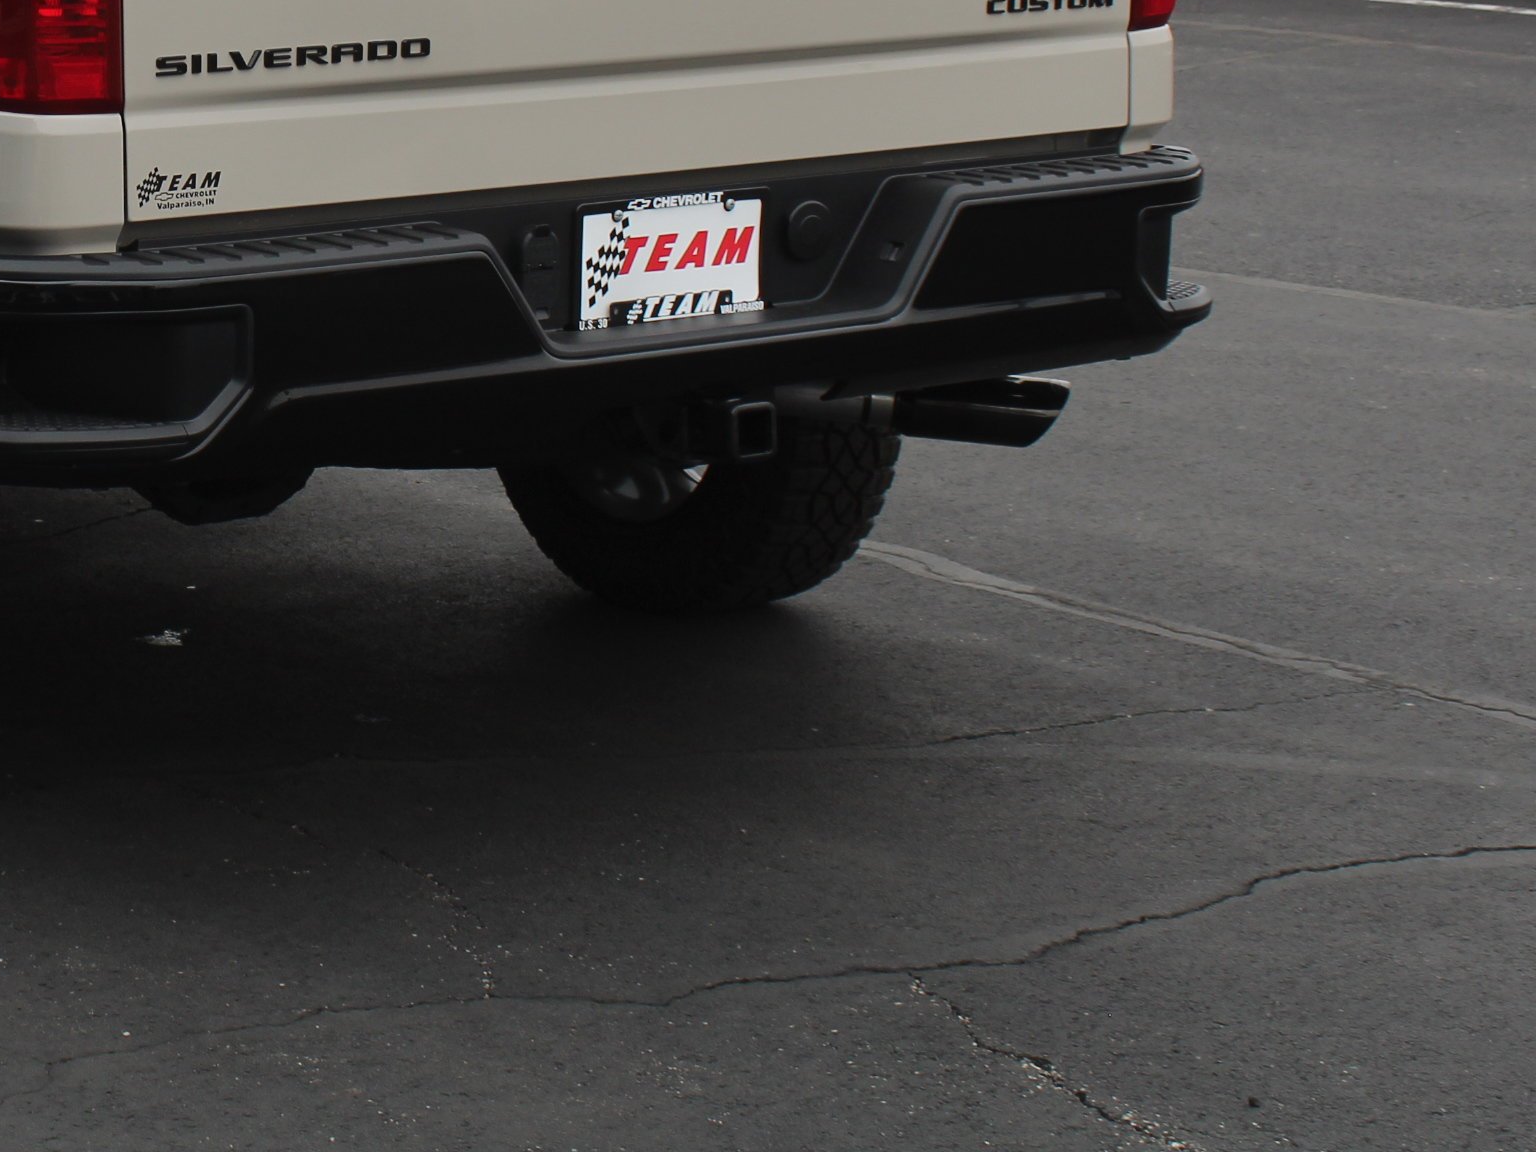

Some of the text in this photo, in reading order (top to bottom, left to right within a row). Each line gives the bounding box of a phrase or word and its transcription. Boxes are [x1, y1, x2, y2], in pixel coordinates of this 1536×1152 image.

[155, 37, 431, 78] SILVERADO
[155, 171, 222, 192] TEAM
[175, 189, 217, 199] CHEVROLET
[652, 191, 724, 209] CHEVROLET
[157, 199, 205, 210] Valparaiso,
[617, 225, 755, 276] TEAM
[643, 289, 720, 320] TEAM
[720, 300, 764, 315] VALPARAISO
[578, 318, 609, 331] U.S. 30
